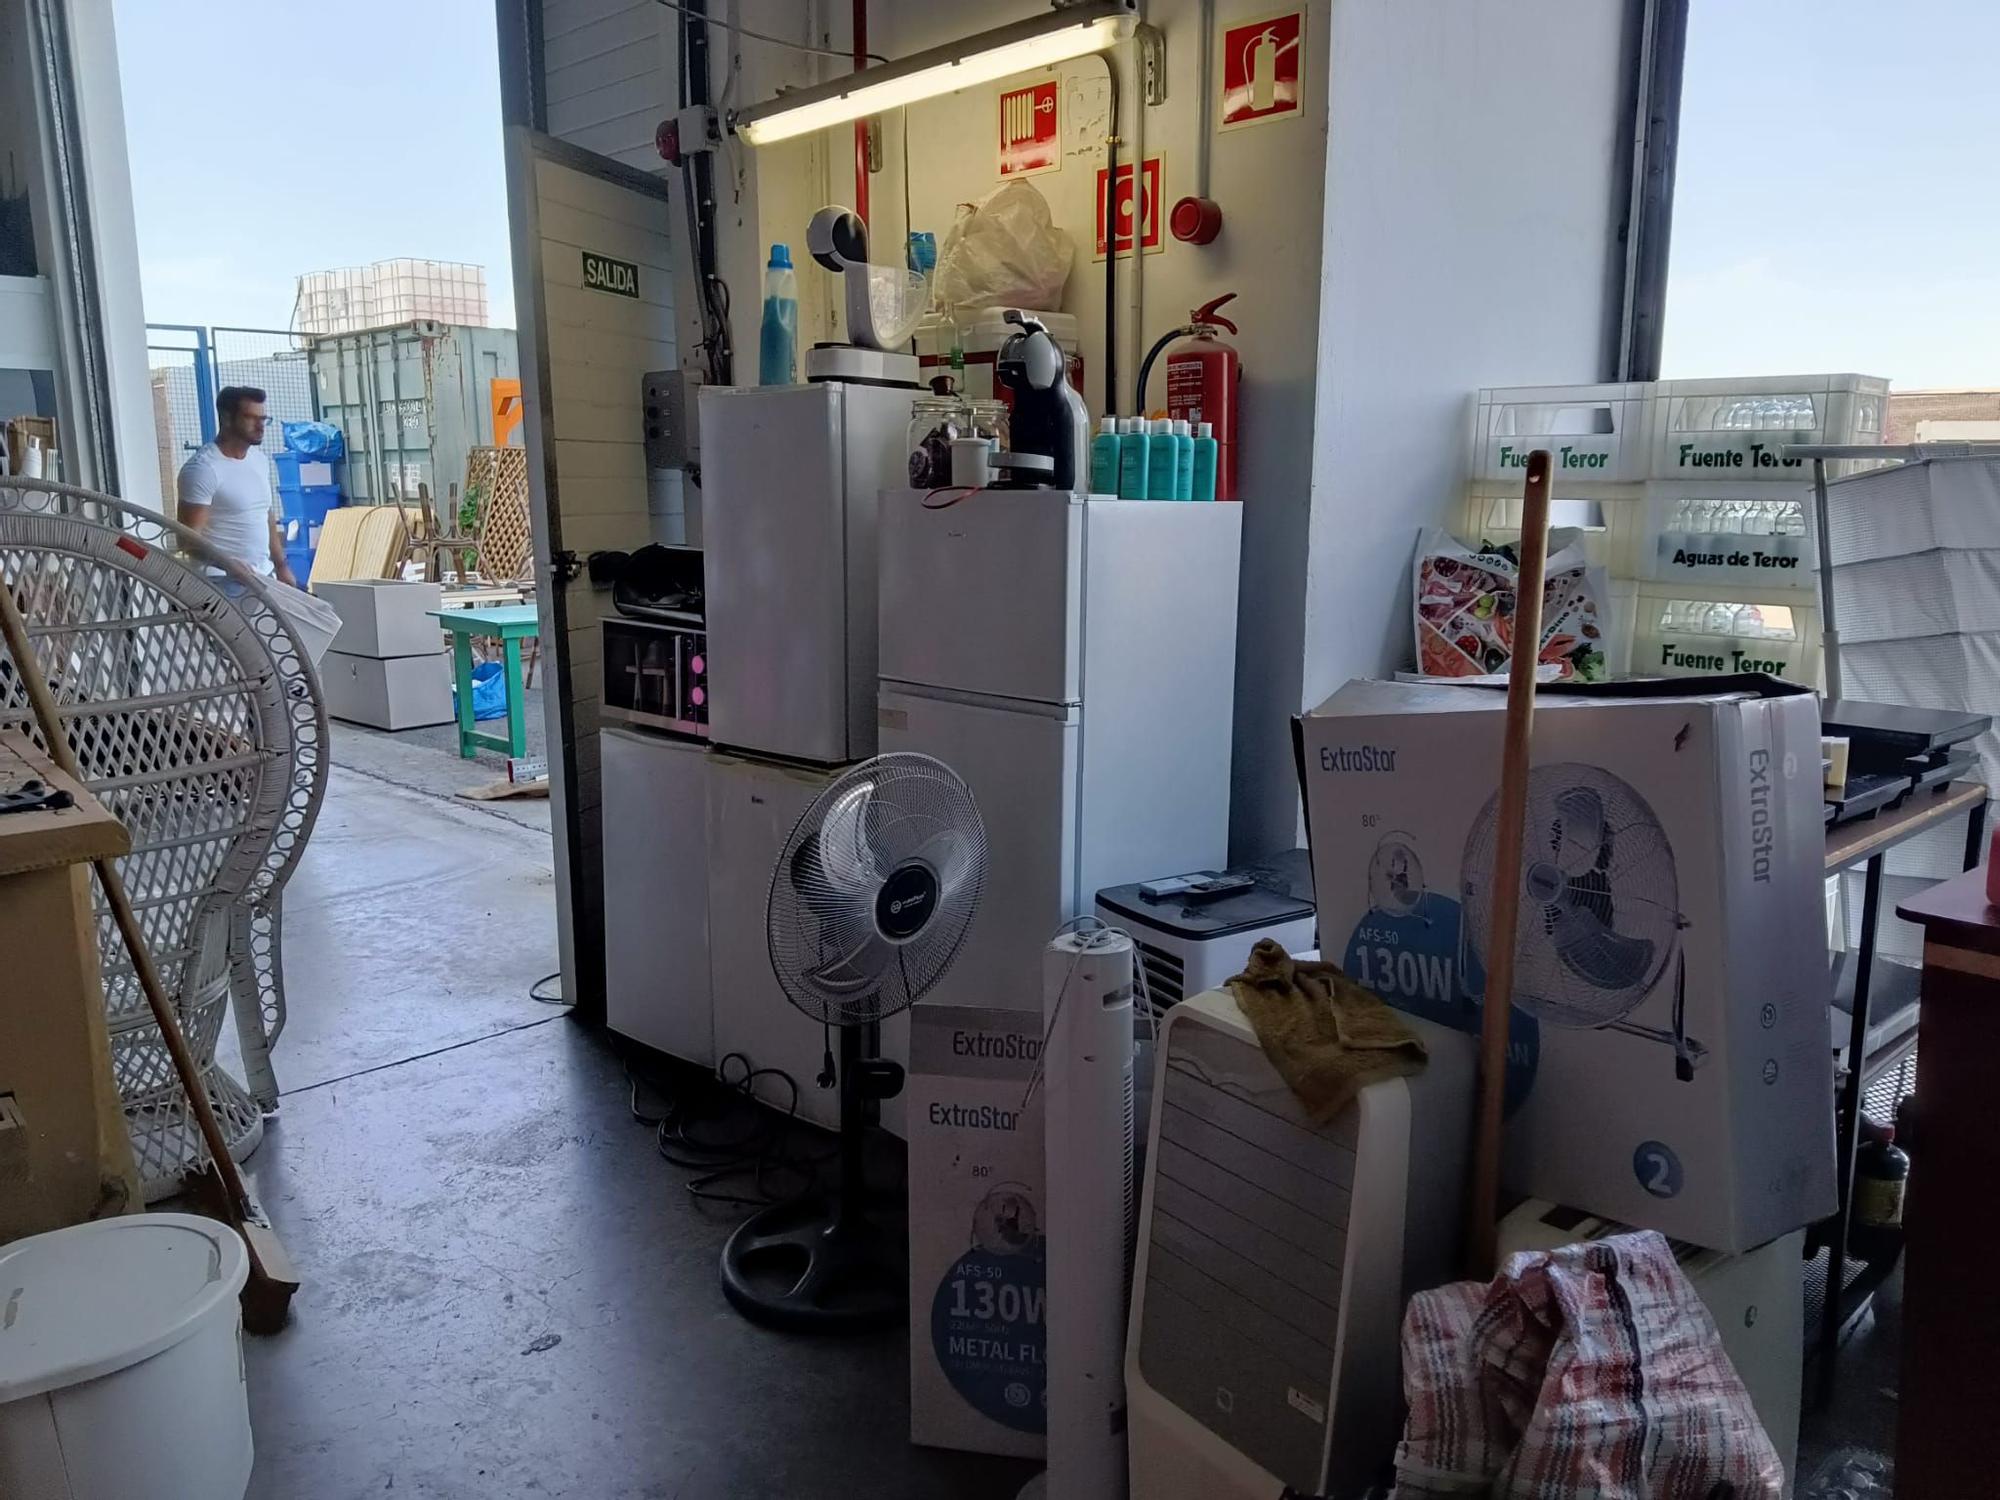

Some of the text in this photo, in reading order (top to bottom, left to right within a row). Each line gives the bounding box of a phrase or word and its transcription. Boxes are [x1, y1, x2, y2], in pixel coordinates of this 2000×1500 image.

[587, 258, 635, 294] SALIDA
[1560, 446, 1609, 468] Teror
[1679, 444, 1743, 468] Fuente
[1672, 549, 1799, 569] Aguas de Teror
[1731, 650, 1787, 676] Teror
[1320, 745, 1396, 772] ExtraStar
[1749, 748, 1773, 884] ExtraStar
[1358, 927, 1400, 945] AFS-50
[1355, 945, 1452, 1003] 130W
[929, 1101, 1019, 1132] ExtraStar
[1646, 1153, 1672, 1194] 2
[956, 1263, 1002, 1279] AFS-50
[949, 1336, 1016, 1361] METAL
